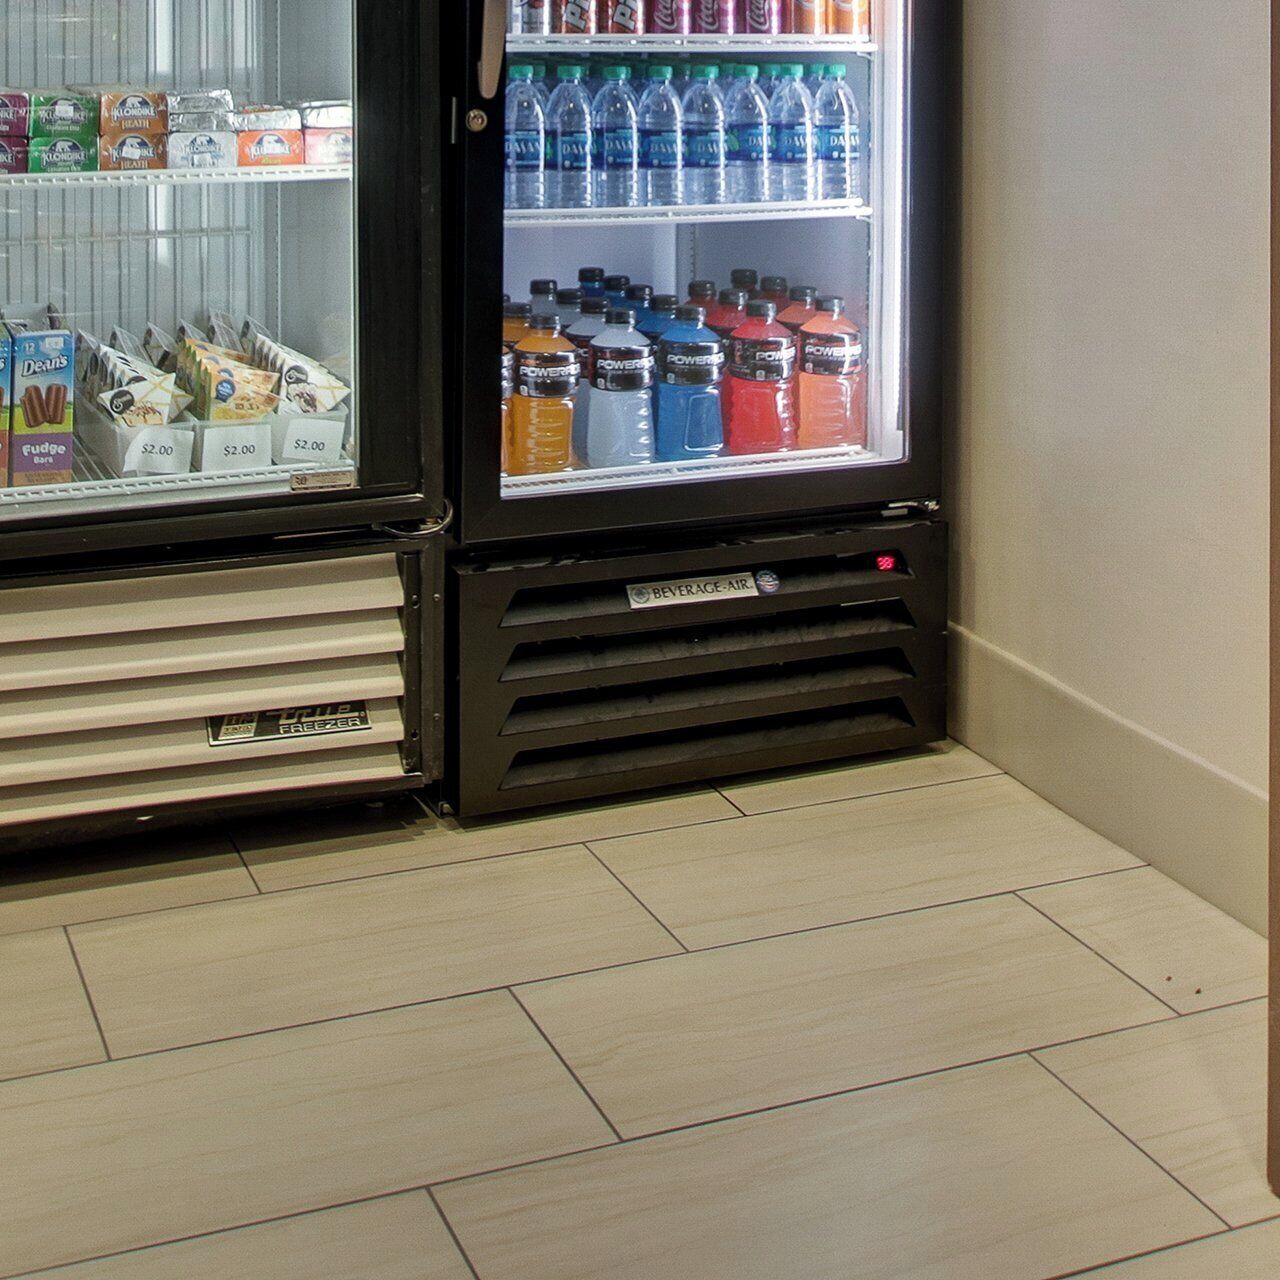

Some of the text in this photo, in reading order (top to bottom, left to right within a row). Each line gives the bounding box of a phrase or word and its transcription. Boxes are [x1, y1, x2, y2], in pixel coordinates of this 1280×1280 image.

[112, 107, 156, 120] KLONDIKE
[122, 119, 149, 129] HEATH
[42, 152, 87, 163] KLONDIKE
[25, 342, 35, 352] 12
[22, 355, 68, 377] Dean's
[22, 443, 66, 456] Fudge
[141, 442, 174, 457] $2.00
[223, 443, 256, 457] $2.00
[294, 438, 326, 453] $2.00
[33, 456, 53, 464] Bars
[651, 577, 752, 600] BEVERAGE-AIR
[278, 716, 362, 735] FREEZER
